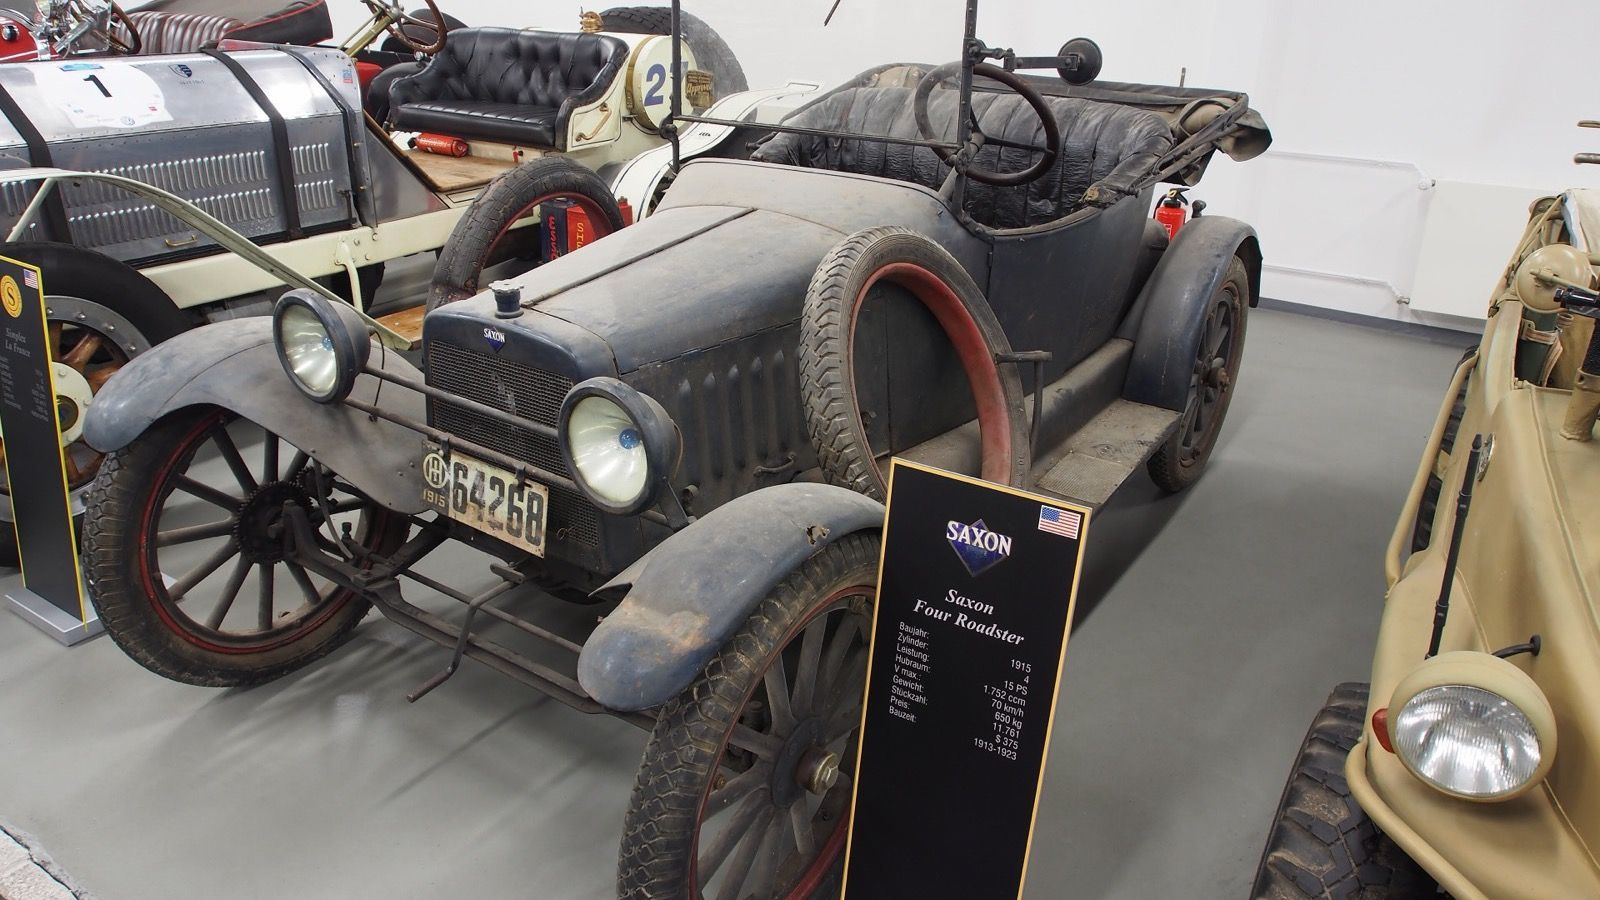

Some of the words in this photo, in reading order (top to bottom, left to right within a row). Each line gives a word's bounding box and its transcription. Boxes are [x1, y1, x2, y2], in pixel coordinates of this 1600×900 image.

[83, 74, 112, 97] 1
[484, 327, 505, 343] SAXON
[423, 488, 447, 508] 1915
[451, 461, 544, 547] 64268
[946, 520, 1012, 557] SAXON
[913, 599, 951, 622] Four
[954, 612, 1025, 646] Roadster
[945, 589, 994, 615] Saxon
[896, 643, 929, 662] Leistung:
[1004, 680, 1014, 691] 15
[1016, 684, 1028, 696] PS
[898, 632, 929, 650] Zylinder:
[1023, 675, 1030, 684] 4
[899, 621, 930, 639] Baujahr:
[1011, 659, 1031, 673] 1915
[893, 674, 924, 693] Gewicht:
[995, 711, 1011, 724] 650
[1012, 718, 1022, 730] kg
[895, 653, 930, 673] Hubraum:
[984, 685, 1006, 700] 1.752
[1008, 694, 1026, 707] ccm
[889, 705, 917, 723] Bauzeit:
[974, 738, 1017, 761] 1913-1923
[890, 695, 910, 709] Preis:
[1002, 737, 1019, 750] 375
[891, 685, 928, 705] Stückzahl:
[993, 722, 1019, 738] 11.761
[991, 698, 1002, 709] 70
[1004, 703, 1024, 717] km/h
